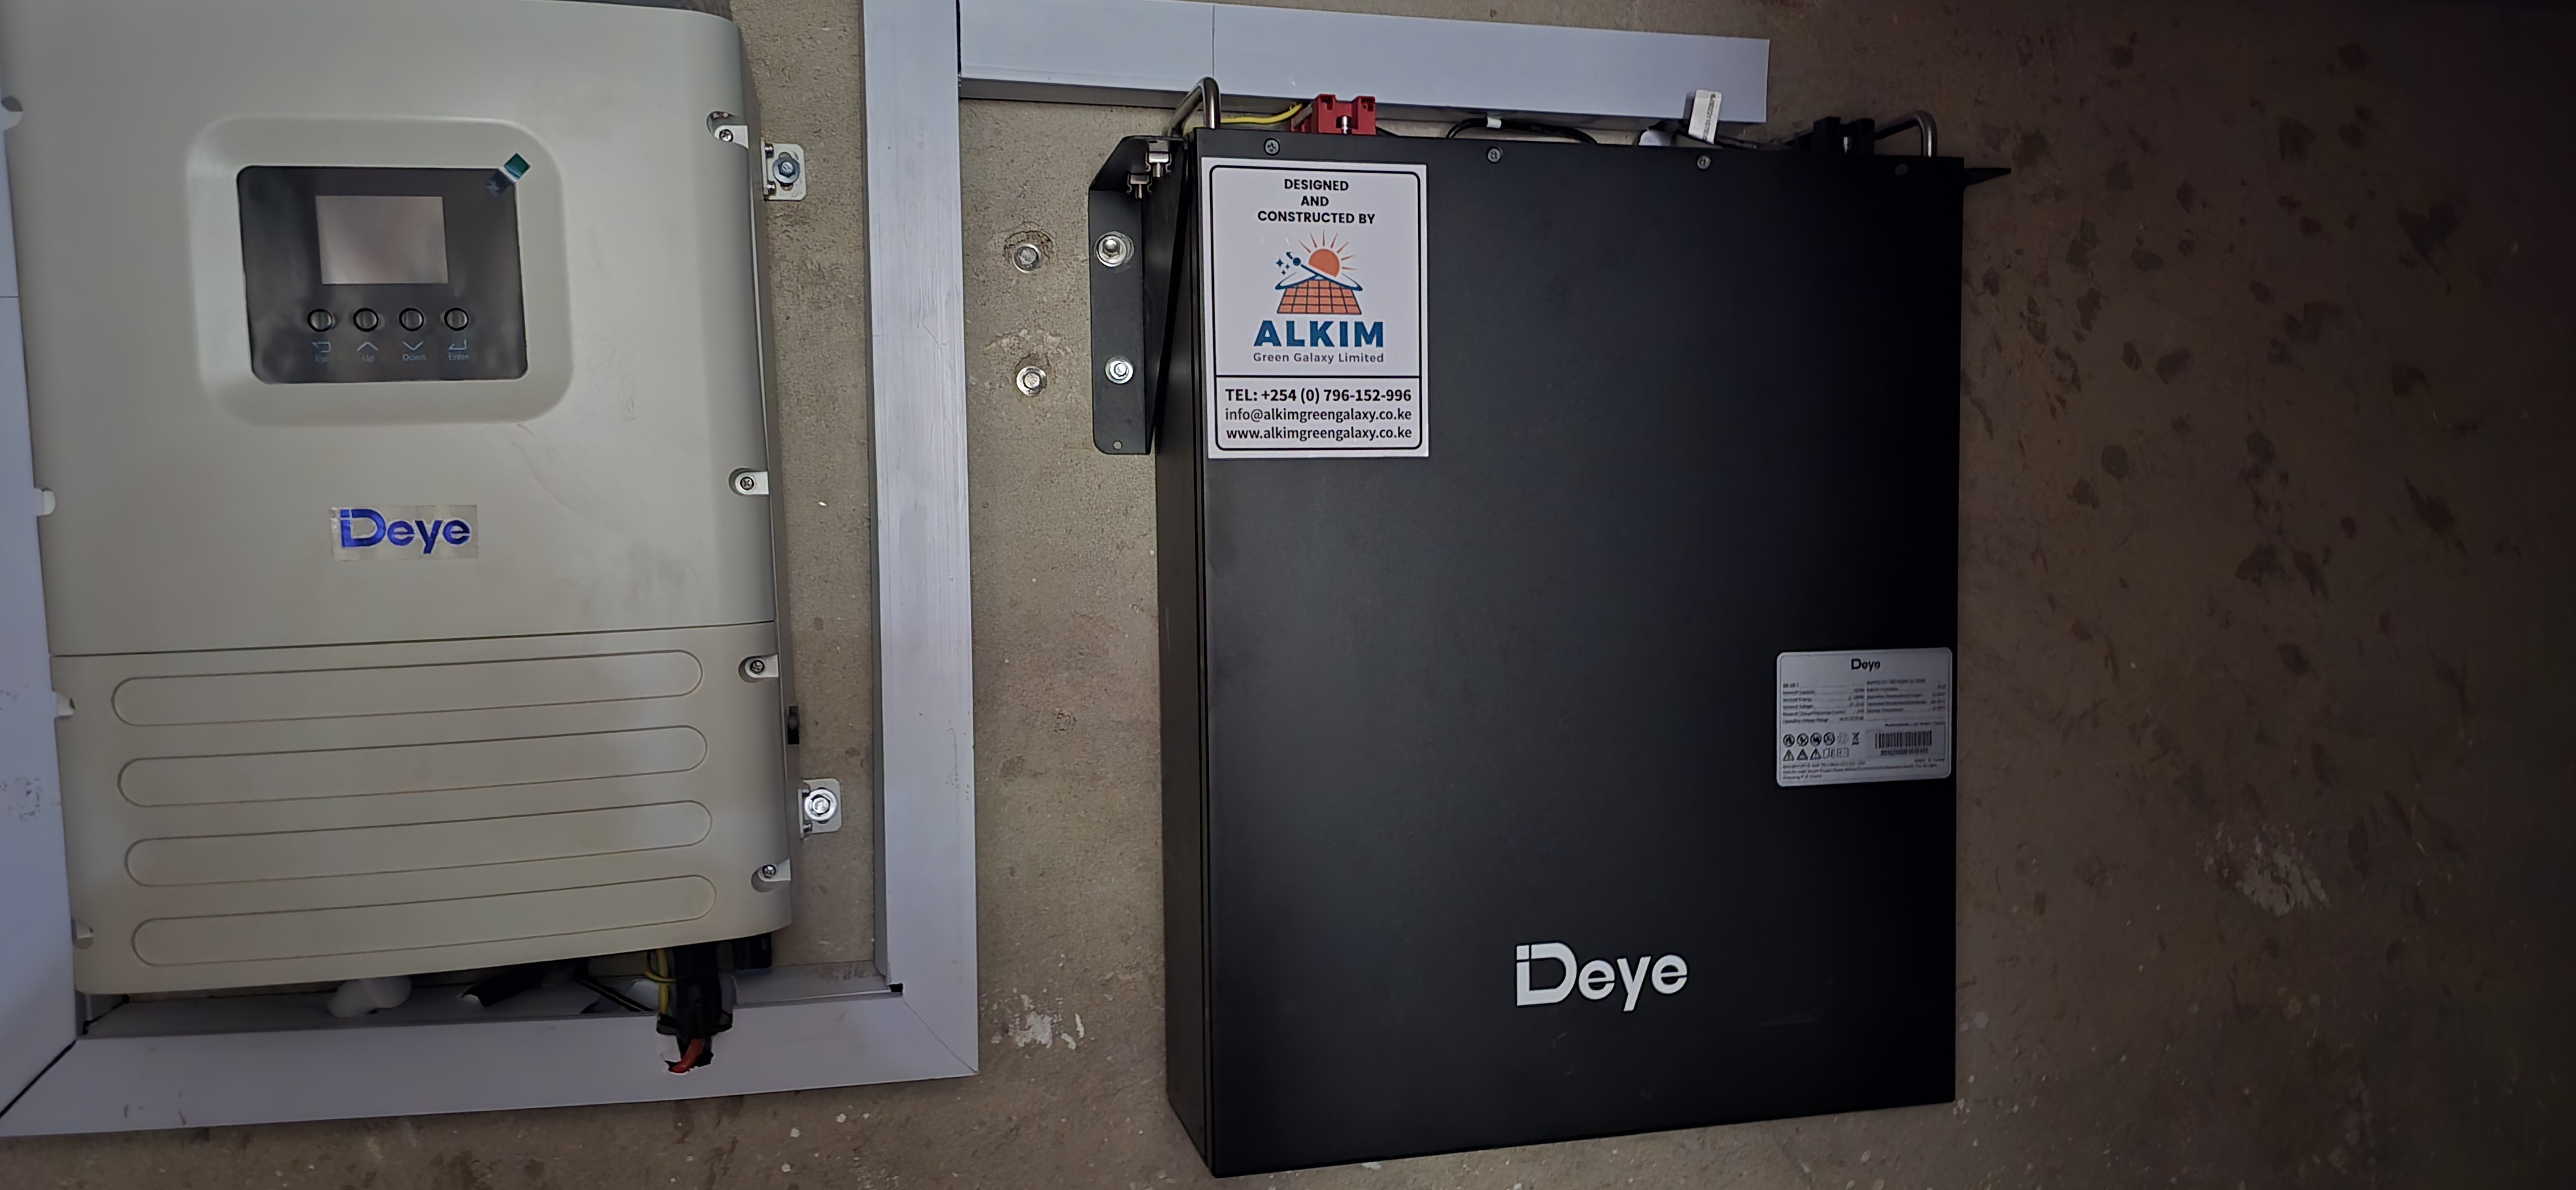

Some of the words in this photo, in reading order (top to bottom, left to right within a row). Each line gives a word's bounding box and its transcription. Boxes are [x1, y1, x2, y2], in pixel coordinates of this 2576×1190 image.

[1283, 178, 1349, 191] DESIGNED
[1300, 196, 1329, 207] AND
[1257, 211, 1355, 223] CONSTRUCTED
[1358, 213, 1376, 224] BY
[1253, 319, 1384, 348] ALKIM
[1253, 352, 1290, 363] Green
[1293, 352, 1334, 364] Galaxy
[1338, 352, 1384, 363] Limited
[1225, 388, 1258, 401] TEL:
[1261, 389, 1297, 401] +254
[1300, 388, 1320, 404] (0)
[1323, 388, 1412, 401] 796-152-996
[1225, 408, 1412, 423] info@alkimgreengalaxy.co.ke
[1226, 427, 1412, 442] www.alkimgreengalaxy.co.ke
[339, 508, 471, 554] Deye
[1516, 942, 1688, 1012] Deye
